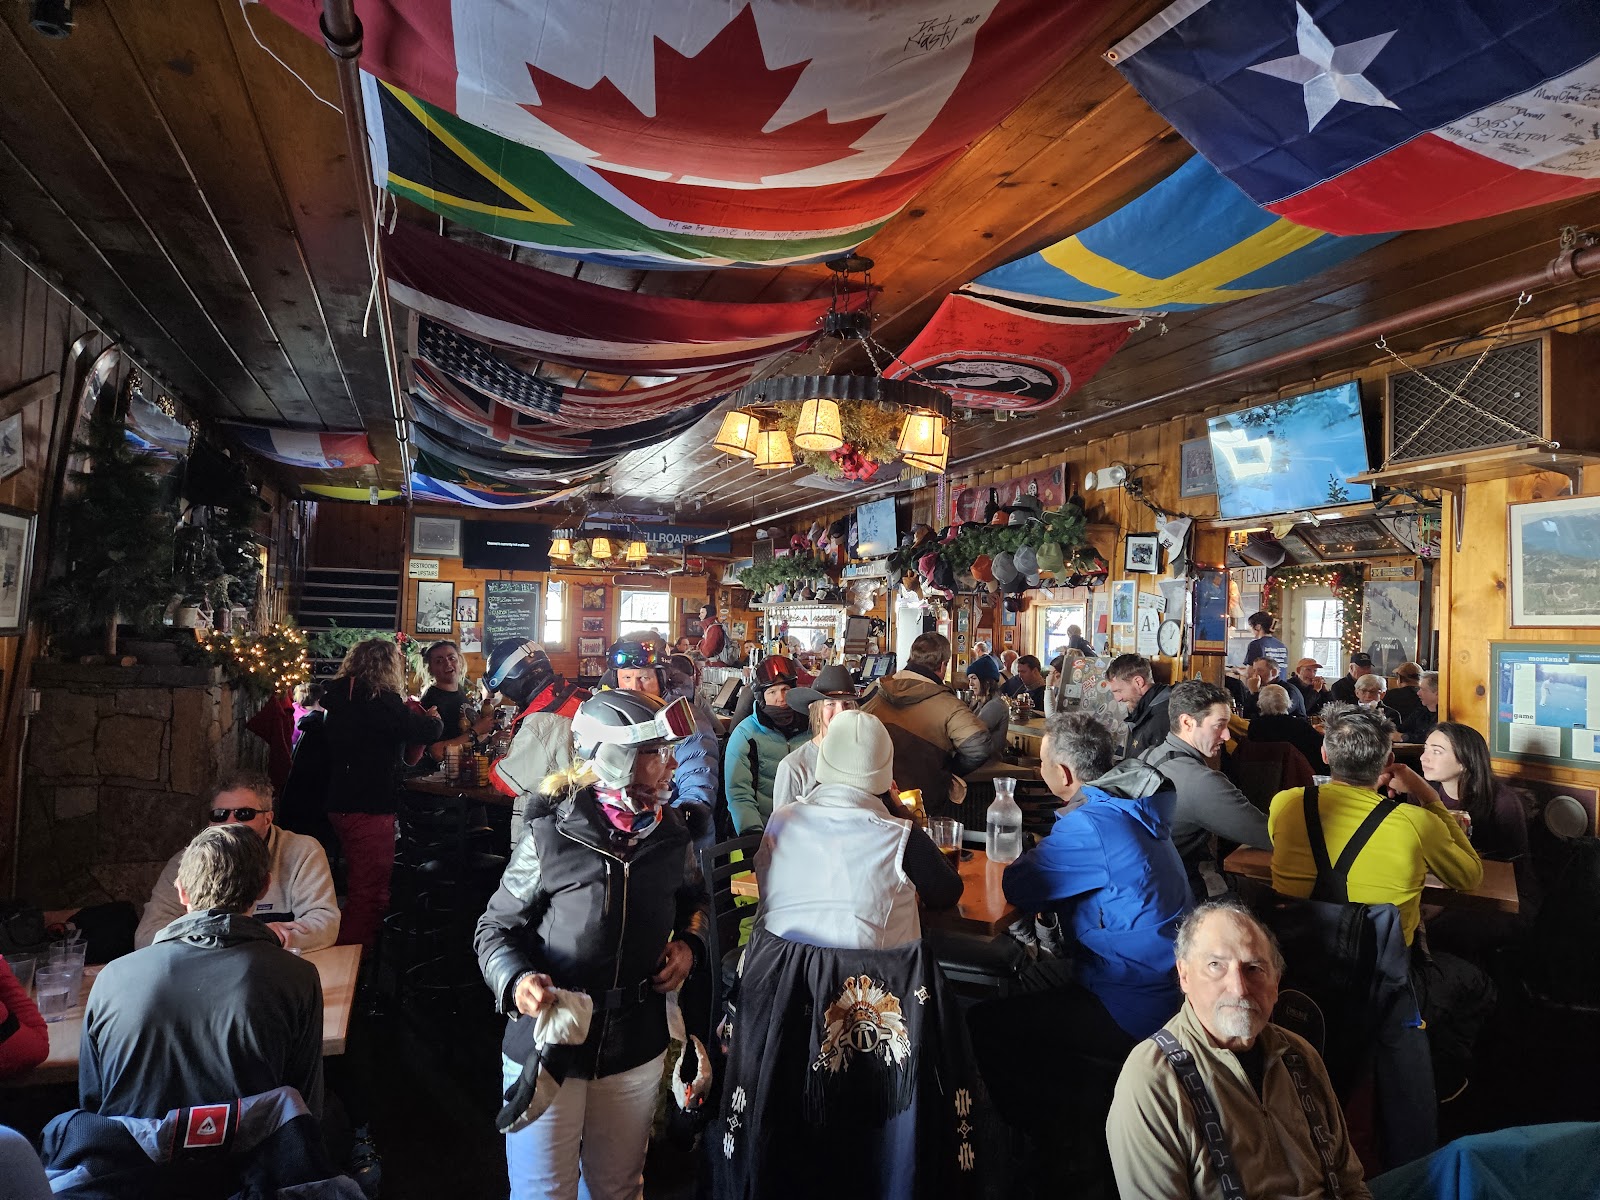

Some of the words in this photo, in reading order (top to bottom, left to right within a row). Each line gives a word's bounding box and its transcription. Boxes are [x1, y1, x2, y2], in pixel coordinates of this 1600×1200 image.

[1480, 128, 1555, 142] STOCKTON
[709, 226, 738, 236] LOVE
[744, 230, 766, 238] WITH
[643, 532, 706, 544] ELLROARING
[1246, 568, 1264, 582] EXIT
[1182, 1072, 1242, 1200] PYDER
